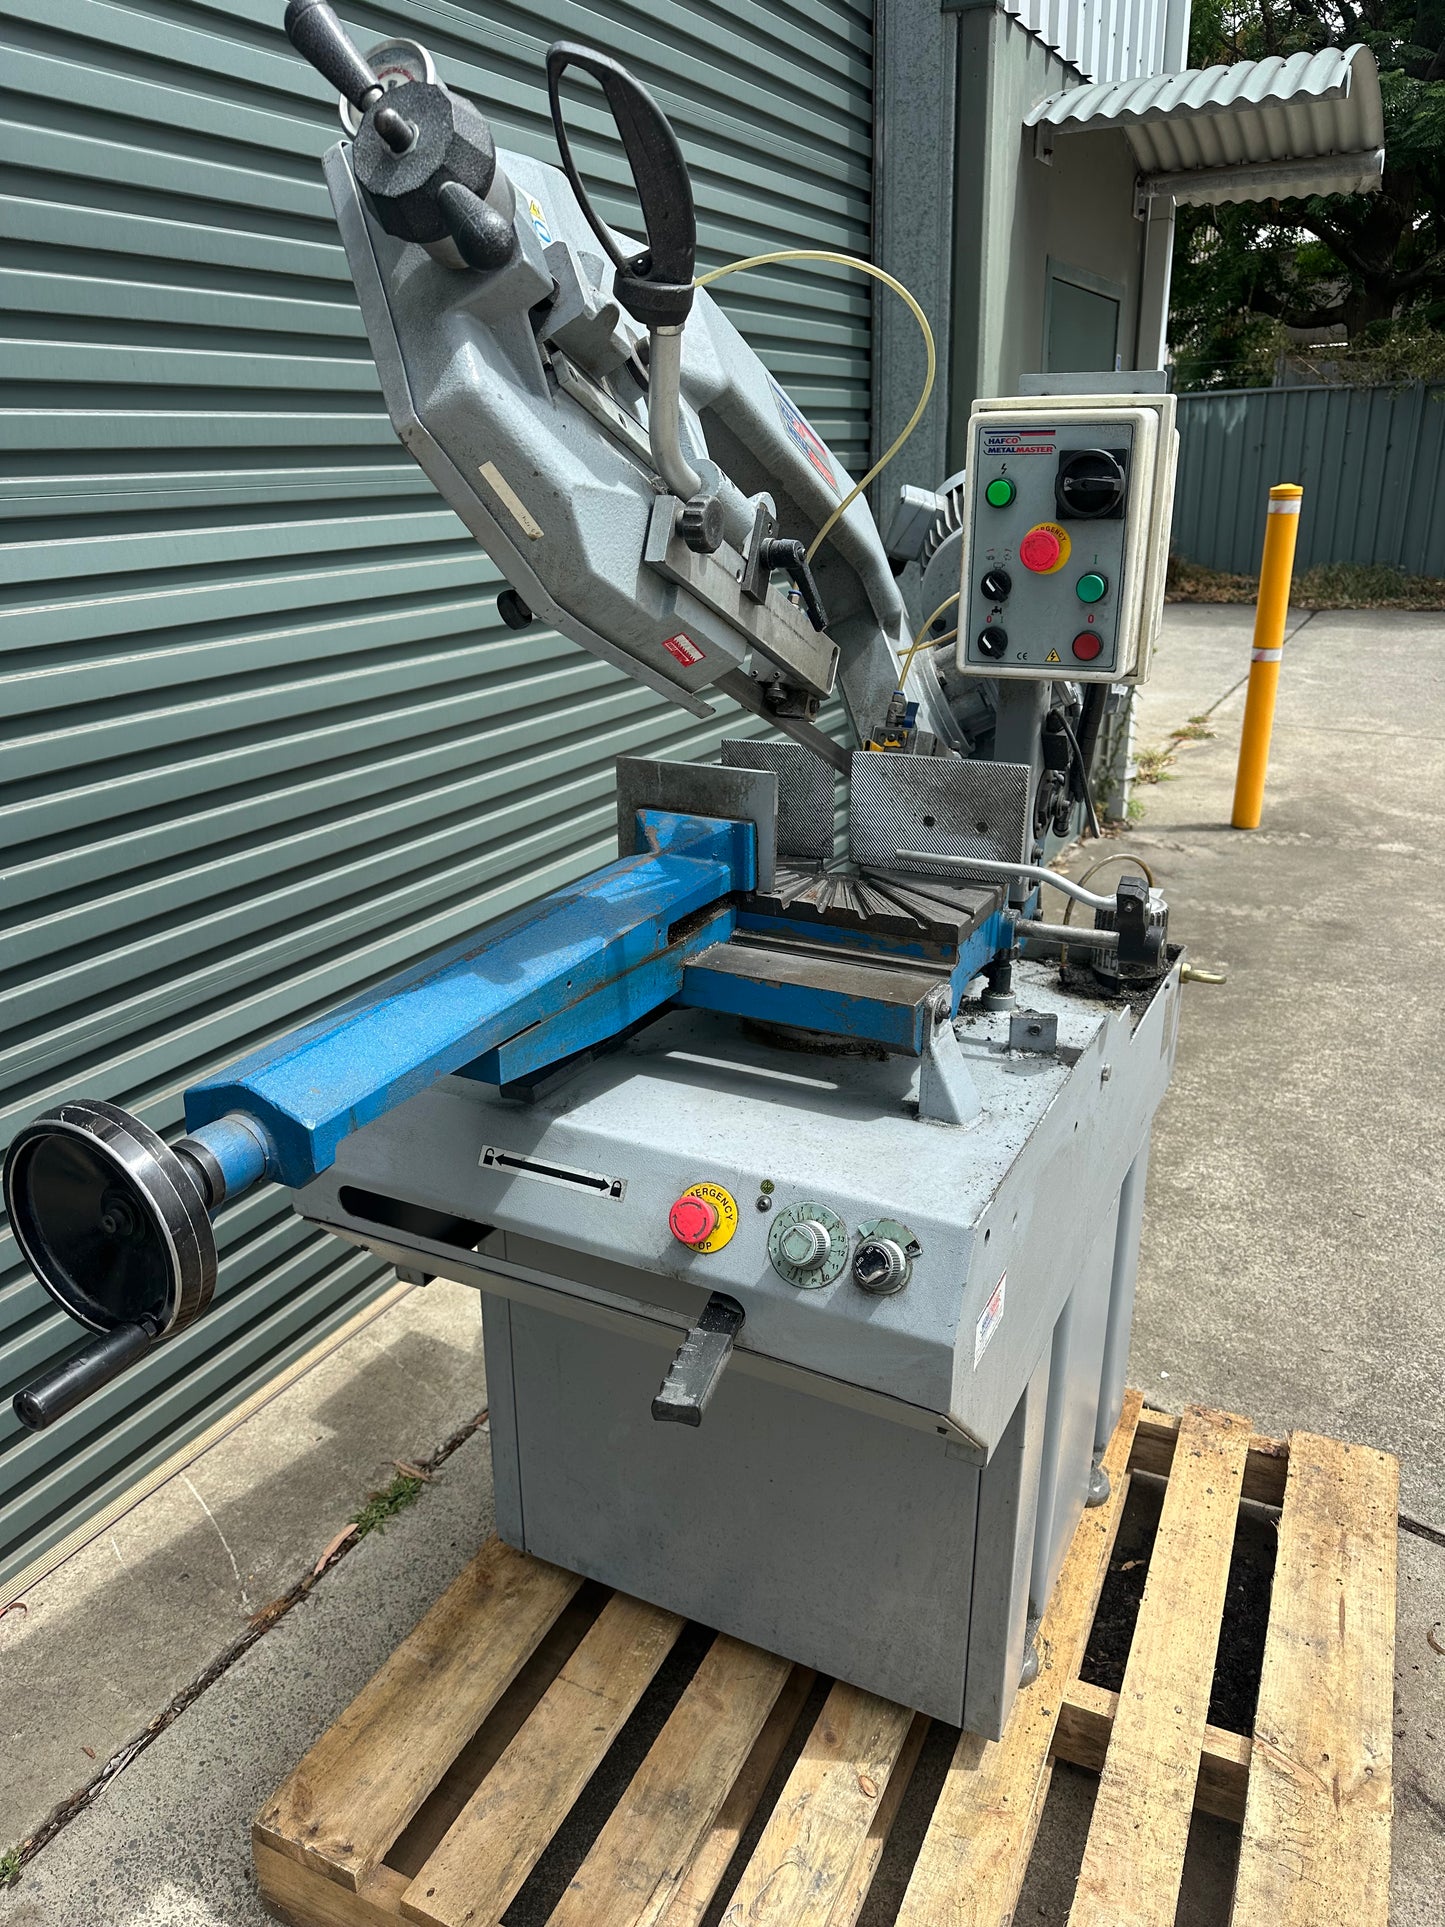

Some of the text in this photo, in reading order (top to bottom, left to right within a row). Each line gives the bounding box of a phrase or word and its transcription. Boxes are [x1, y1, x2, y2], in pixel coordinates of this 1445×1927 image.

[987, 446, 1054, 454] METALMASTER
[1016, 652, 1028, 660] CE
[832, 1263, 839, 1271] 11
